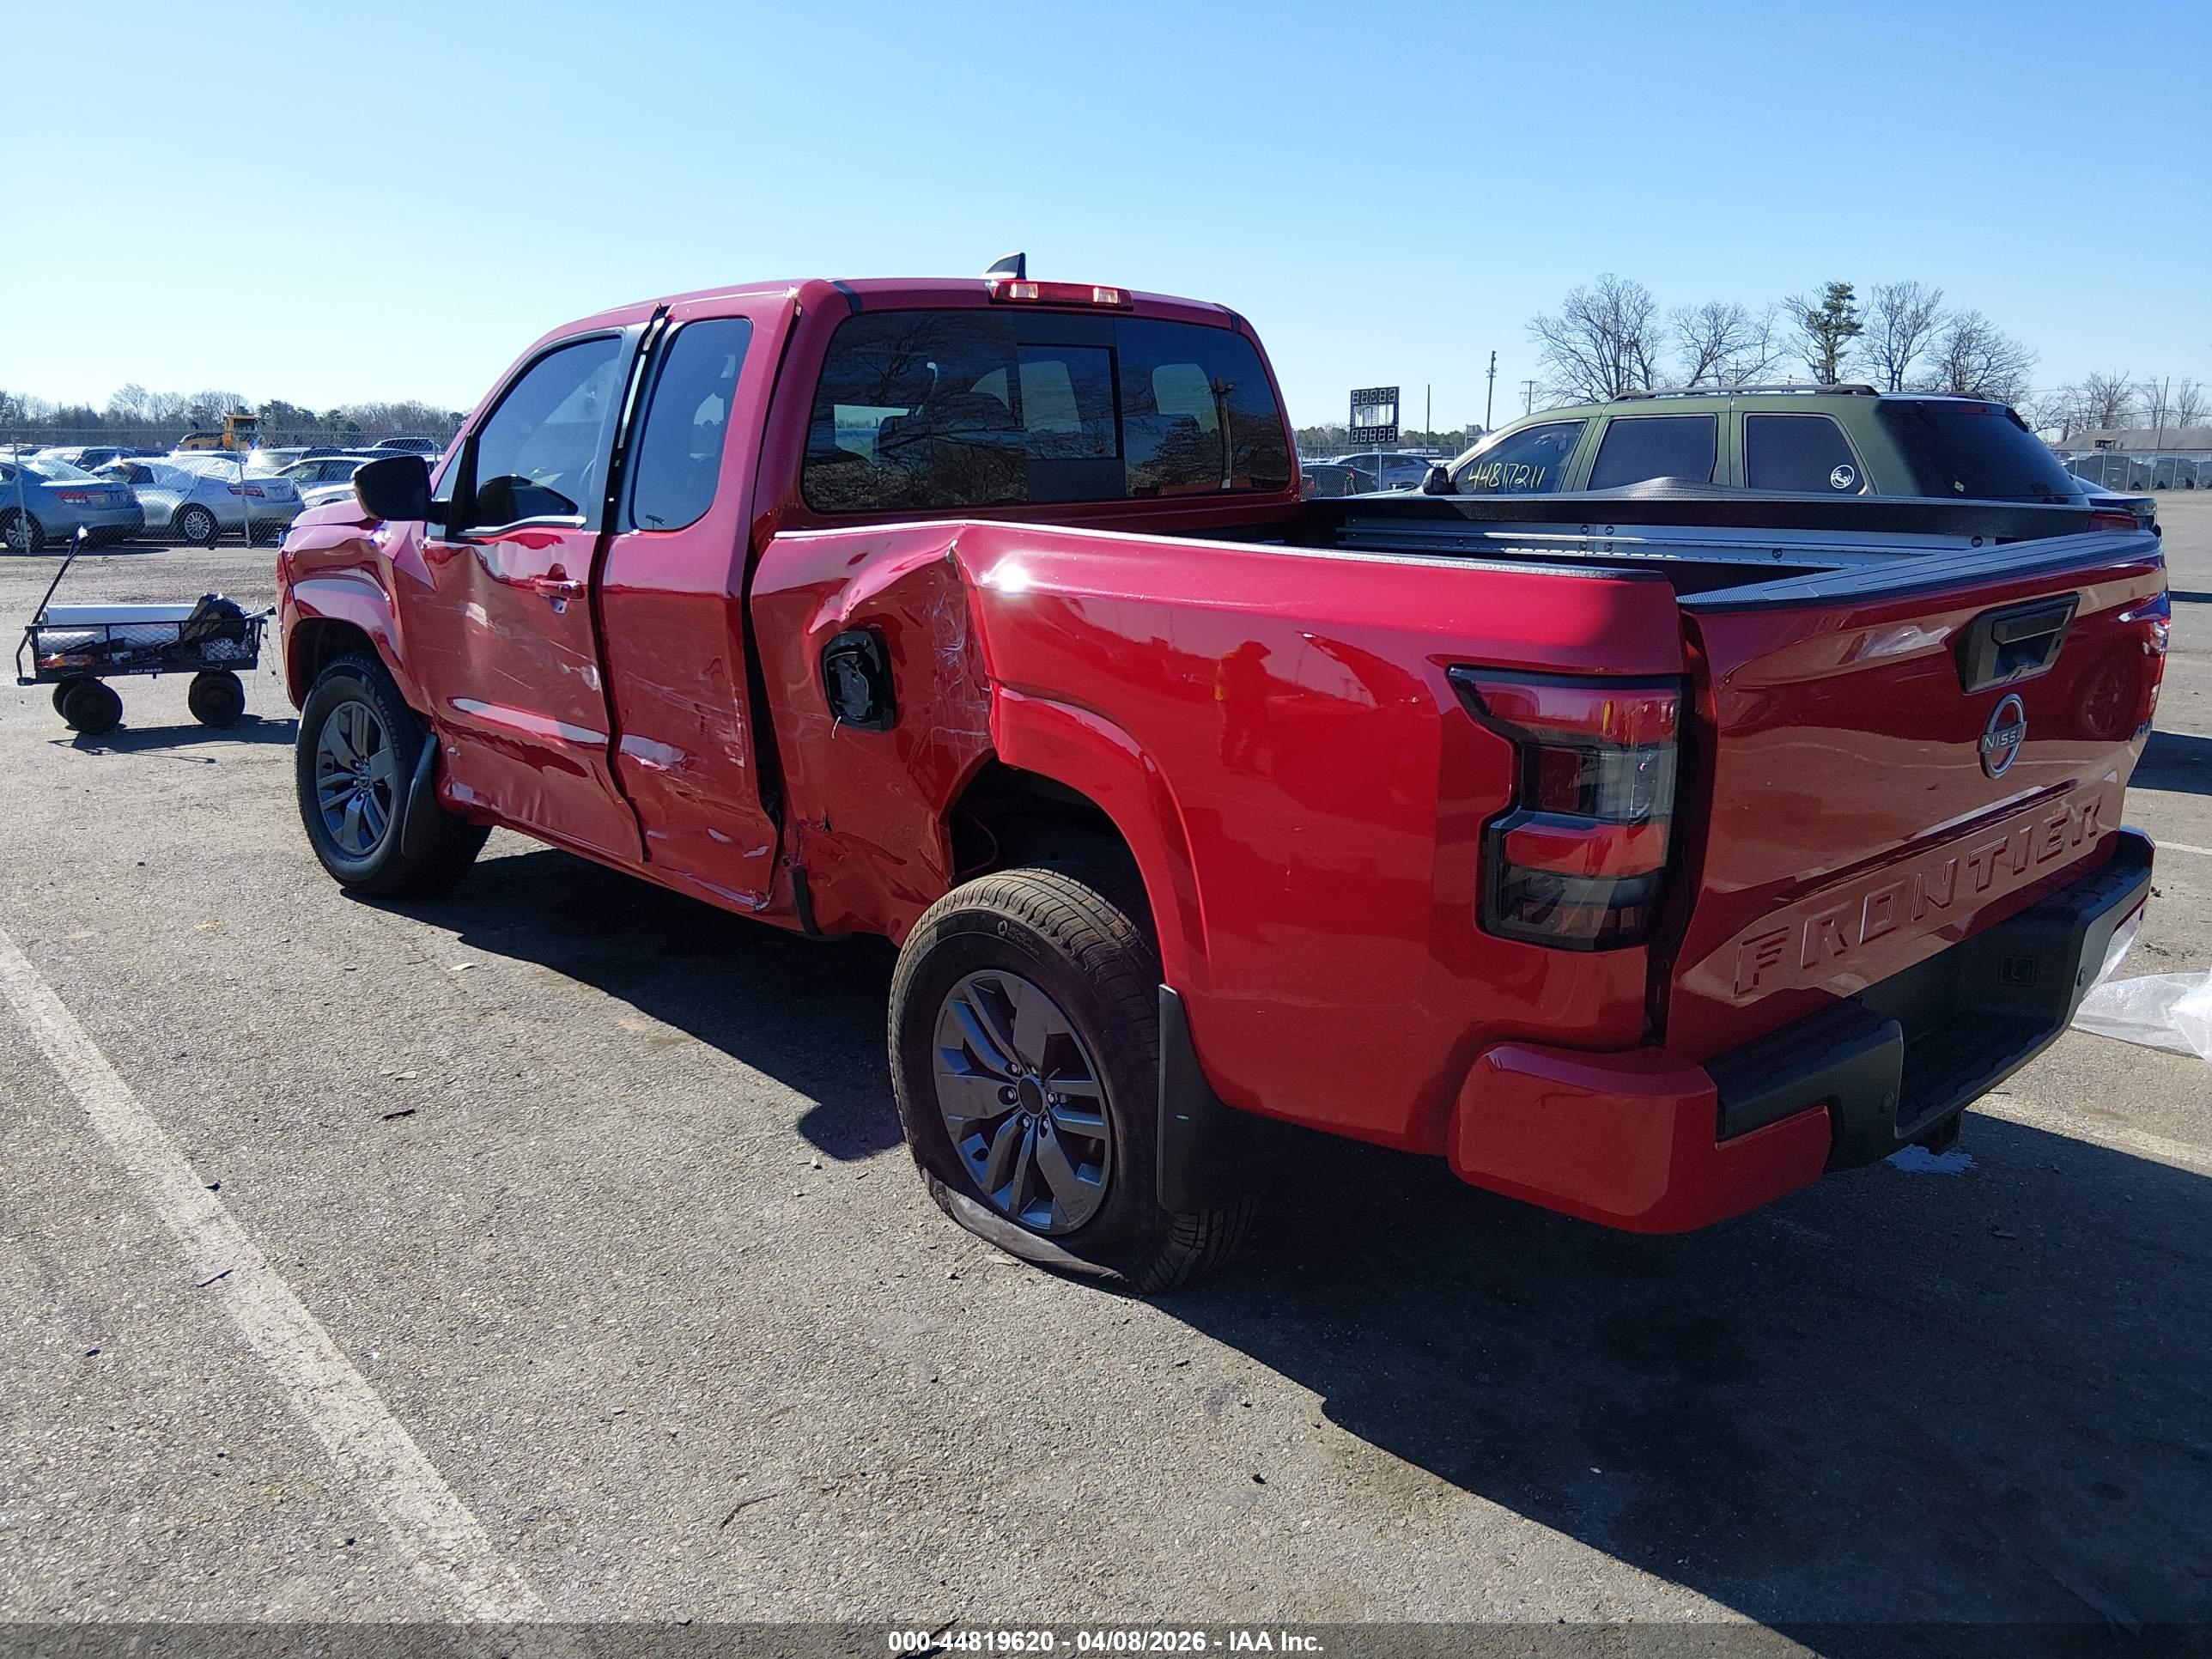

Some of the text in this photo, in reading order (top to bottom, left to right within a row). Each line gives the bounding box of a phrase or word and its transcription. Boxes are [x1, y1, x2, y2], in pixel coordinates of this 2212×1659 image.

[1468, 462, 1546, 489] 44817211
[1984, 727, 2022, 750] NISS
[1732, 795, 2102, 998] FRONTIER
